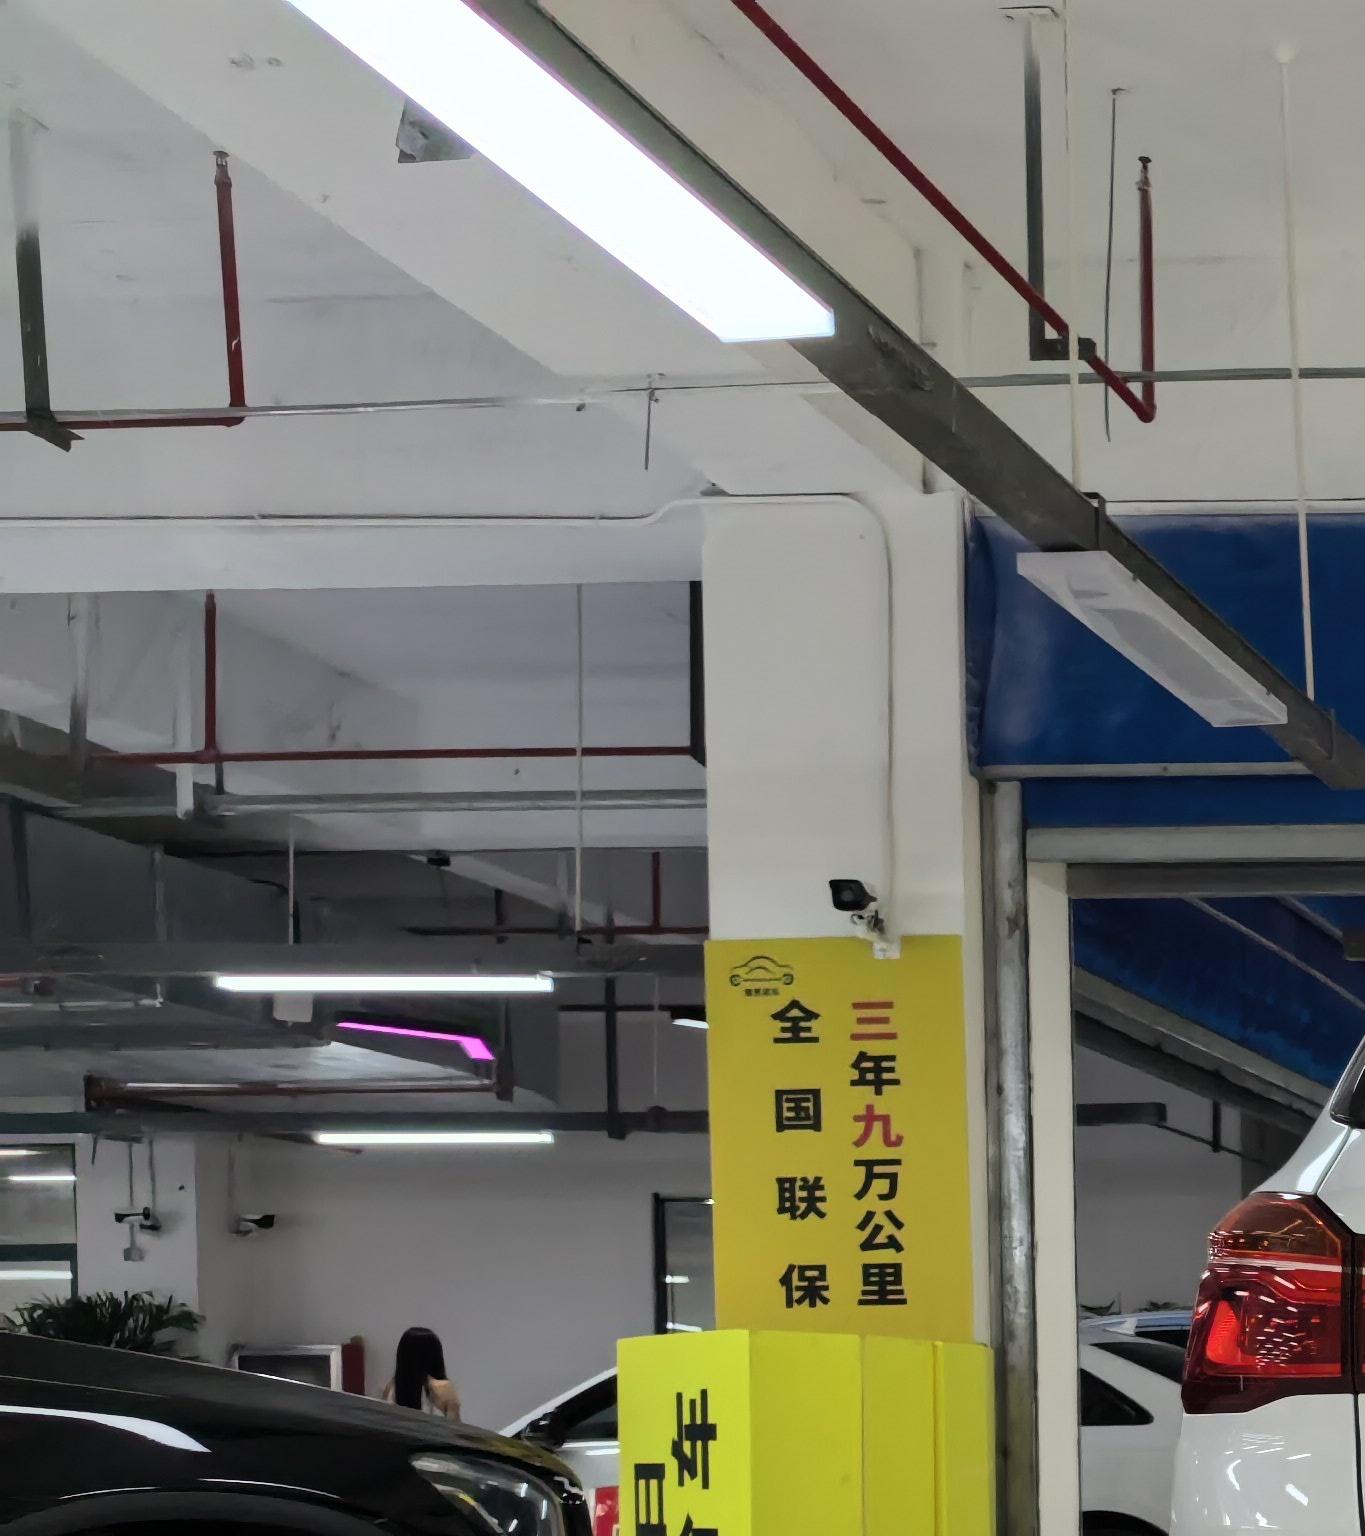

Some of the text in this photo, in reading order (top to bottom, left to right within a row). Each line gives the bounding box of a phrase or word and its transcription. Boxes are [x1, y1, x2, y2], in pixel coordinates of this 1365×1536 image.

[770, 999, 831, 1309] 全国联保
[849, 1000, 908, 1306] 三年九万公里
